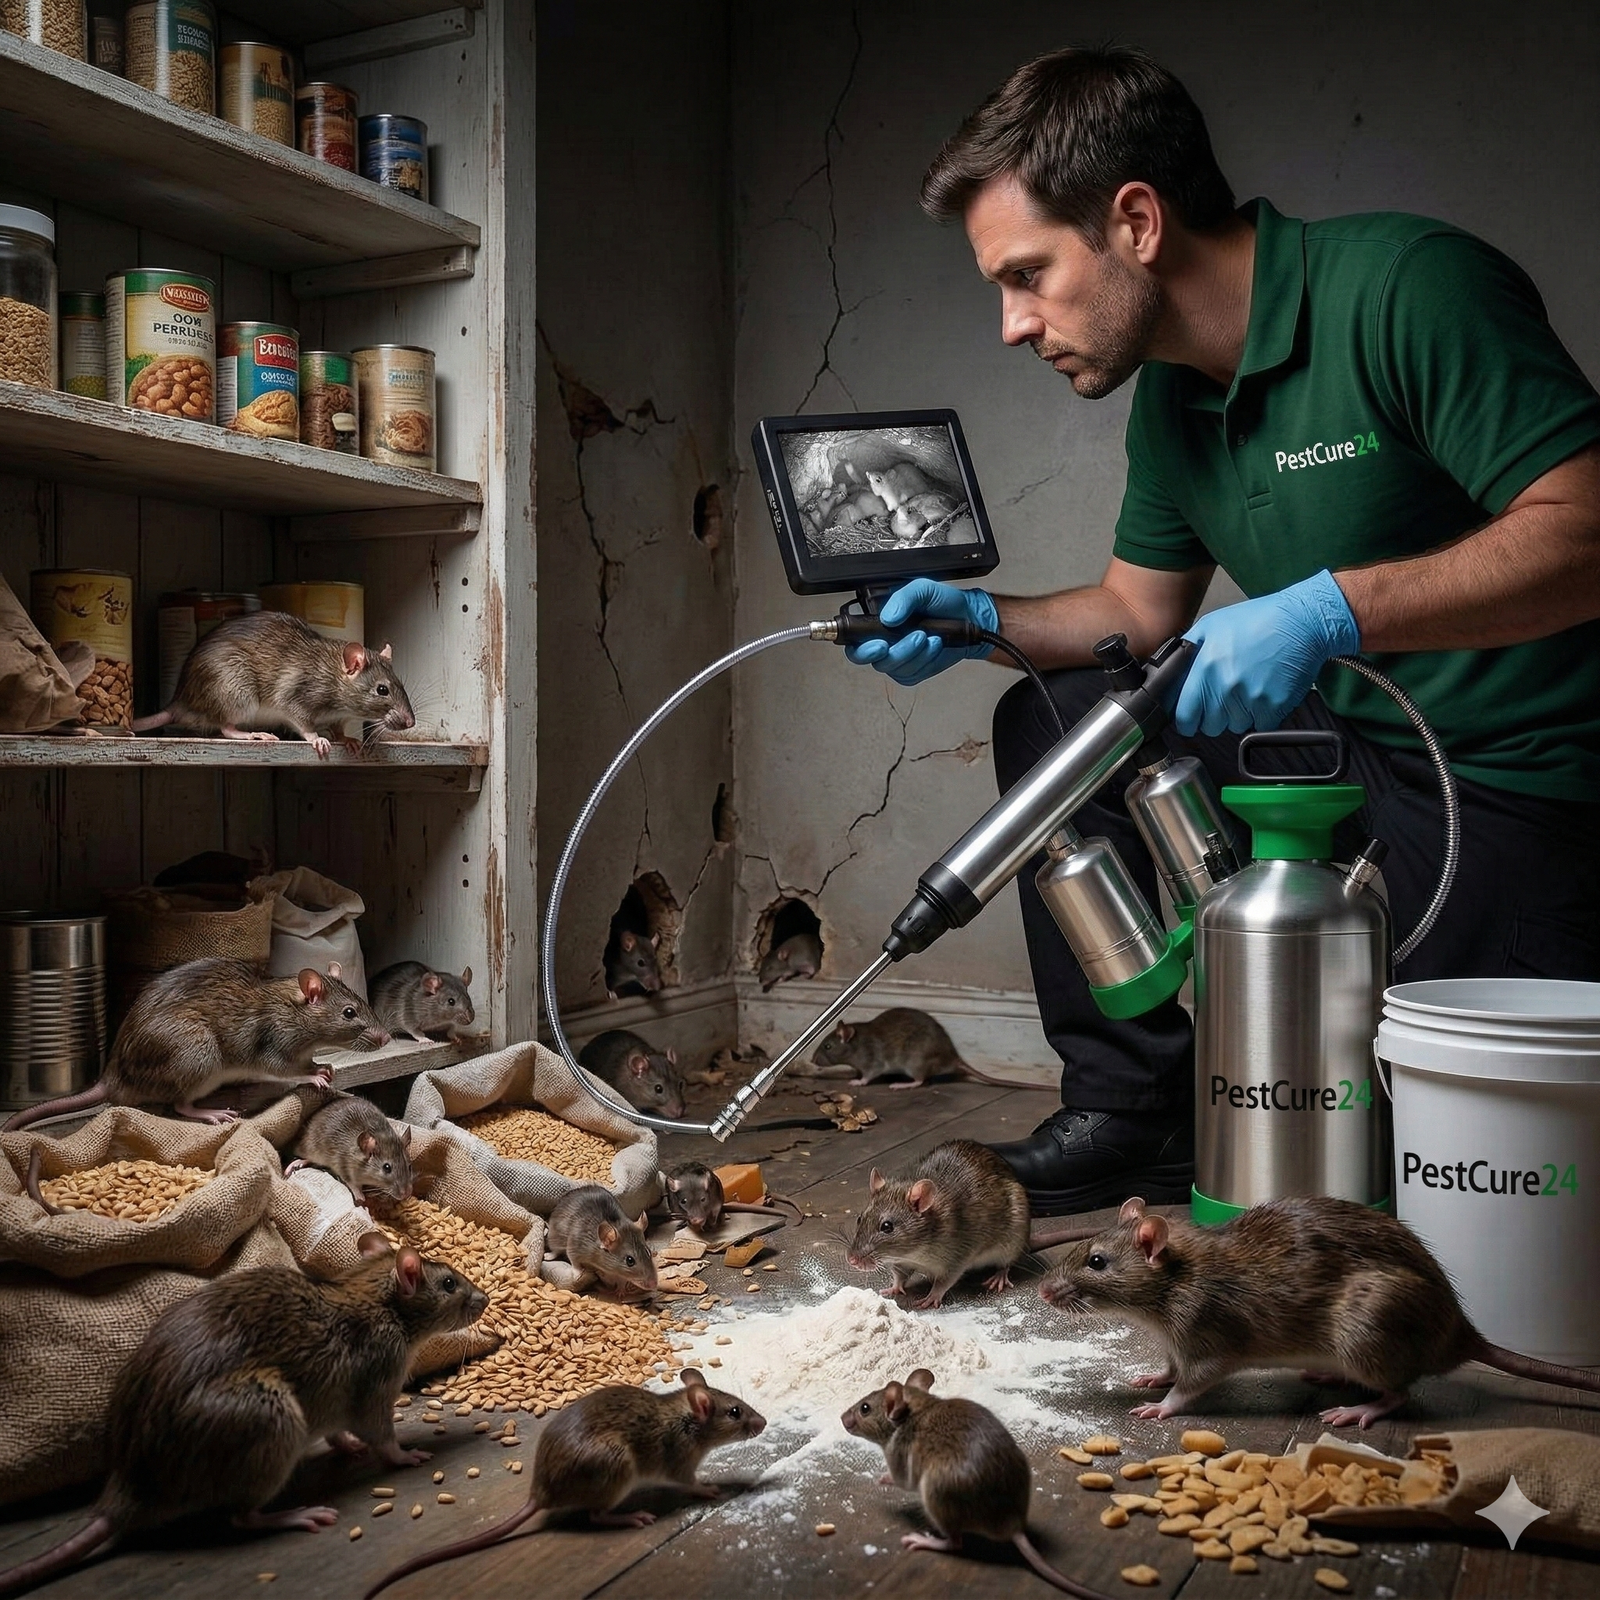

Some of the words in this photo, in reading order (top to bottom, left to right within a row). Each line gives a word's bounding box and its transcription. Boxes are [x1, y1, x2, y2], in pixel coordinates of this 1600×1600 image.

[1274, 431, 1380, 473] PestCure24
[1211, 1075, 1373, 1111] PestCure24
[1403, 1152, 1580, 1196] PestCure24
